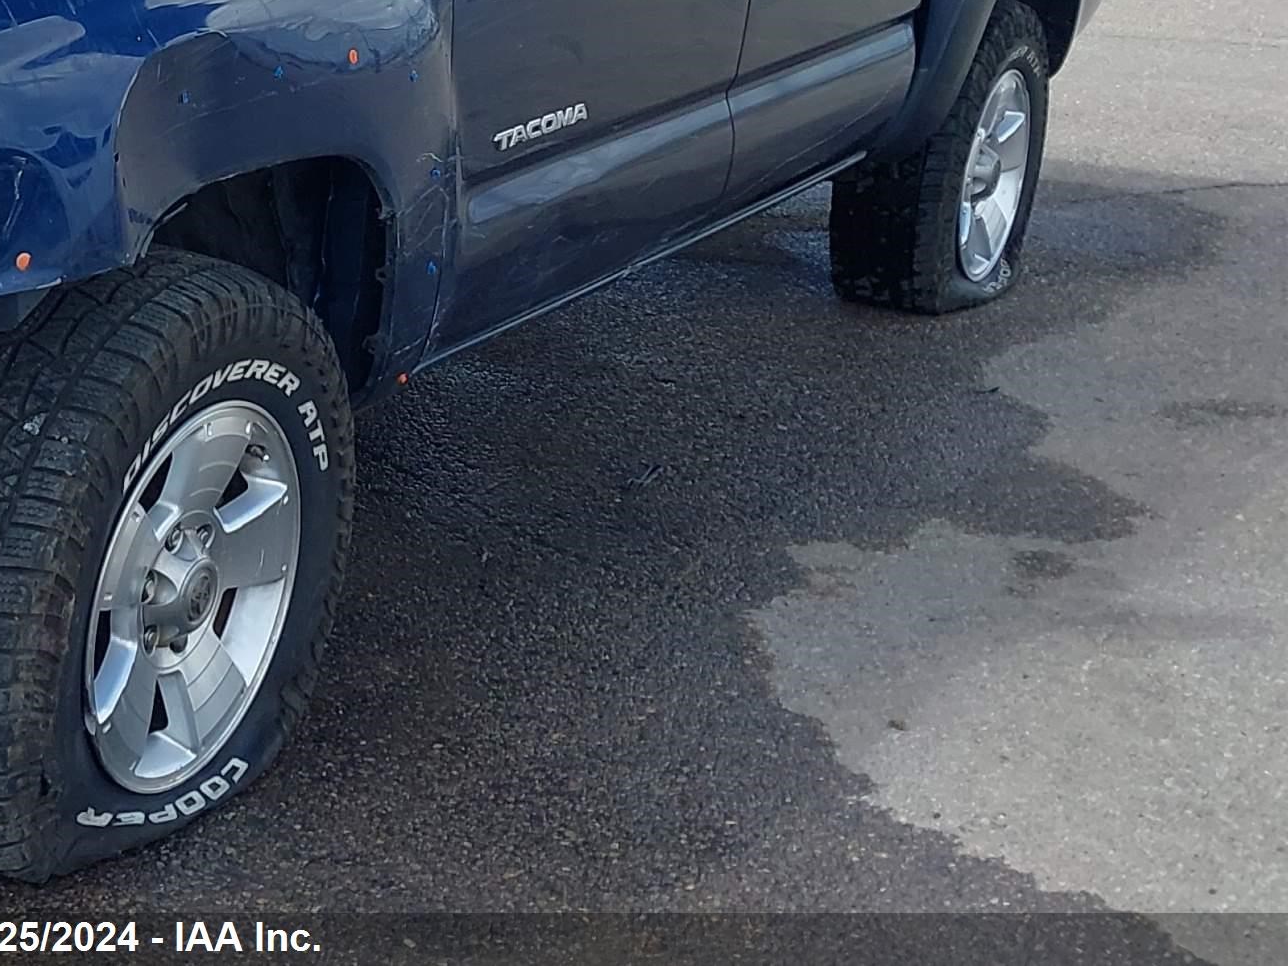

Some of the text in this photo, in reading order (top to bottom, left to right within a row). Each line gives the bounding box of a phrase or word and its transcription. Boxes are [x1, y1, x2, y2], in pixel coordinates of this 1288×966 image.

[493, 102, 589, 152] TACOMA
[123, 358, 329, 497] DISCOVERER ATP
[75, 756, 250, 828] COOPER
